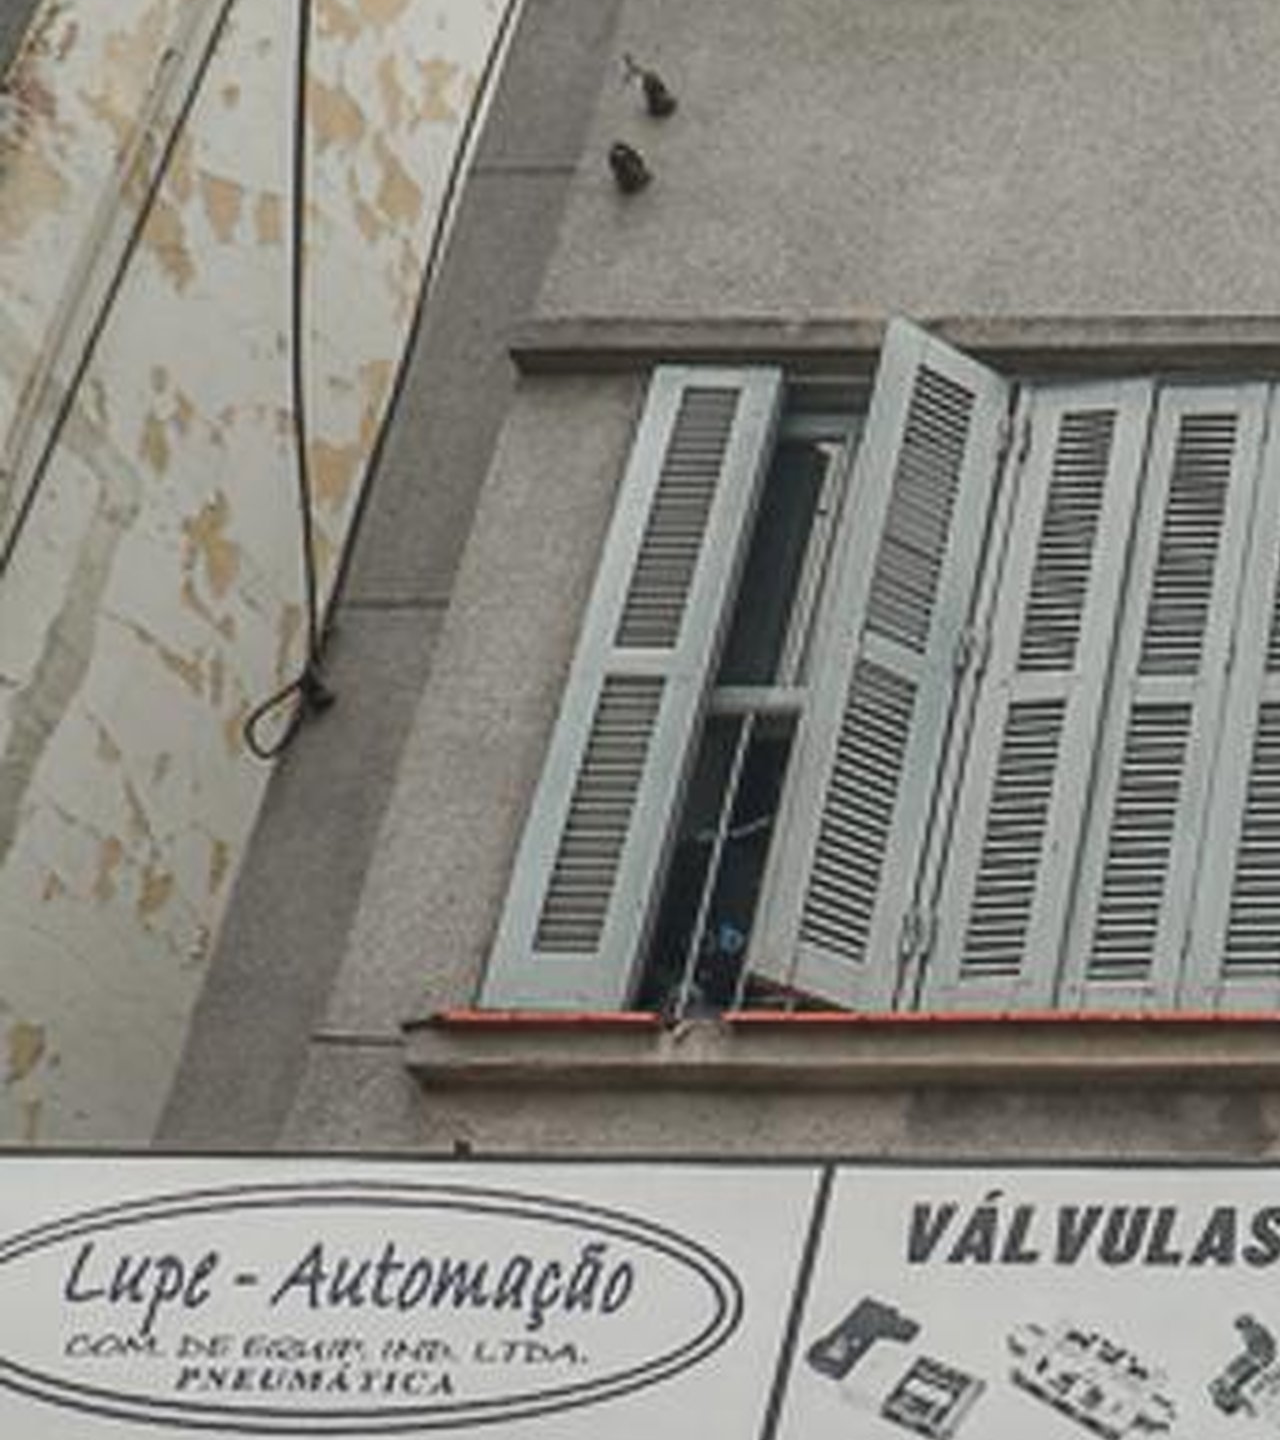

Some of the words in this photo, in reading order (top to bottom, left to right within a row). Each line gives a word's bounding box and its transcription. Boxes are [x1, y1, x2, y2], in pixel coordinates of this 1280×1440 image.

[64, 1242, 219, 1335] Lupe
[270, 1242, 634, 1331] Automação
[64, 1333, 160, 1358] COM.
[176, 1334, 229, 1359] DE
[474, 1340, 589, 1366] LTDA.
[176, 1363, 455, 1396] PNEUMÁTICA
